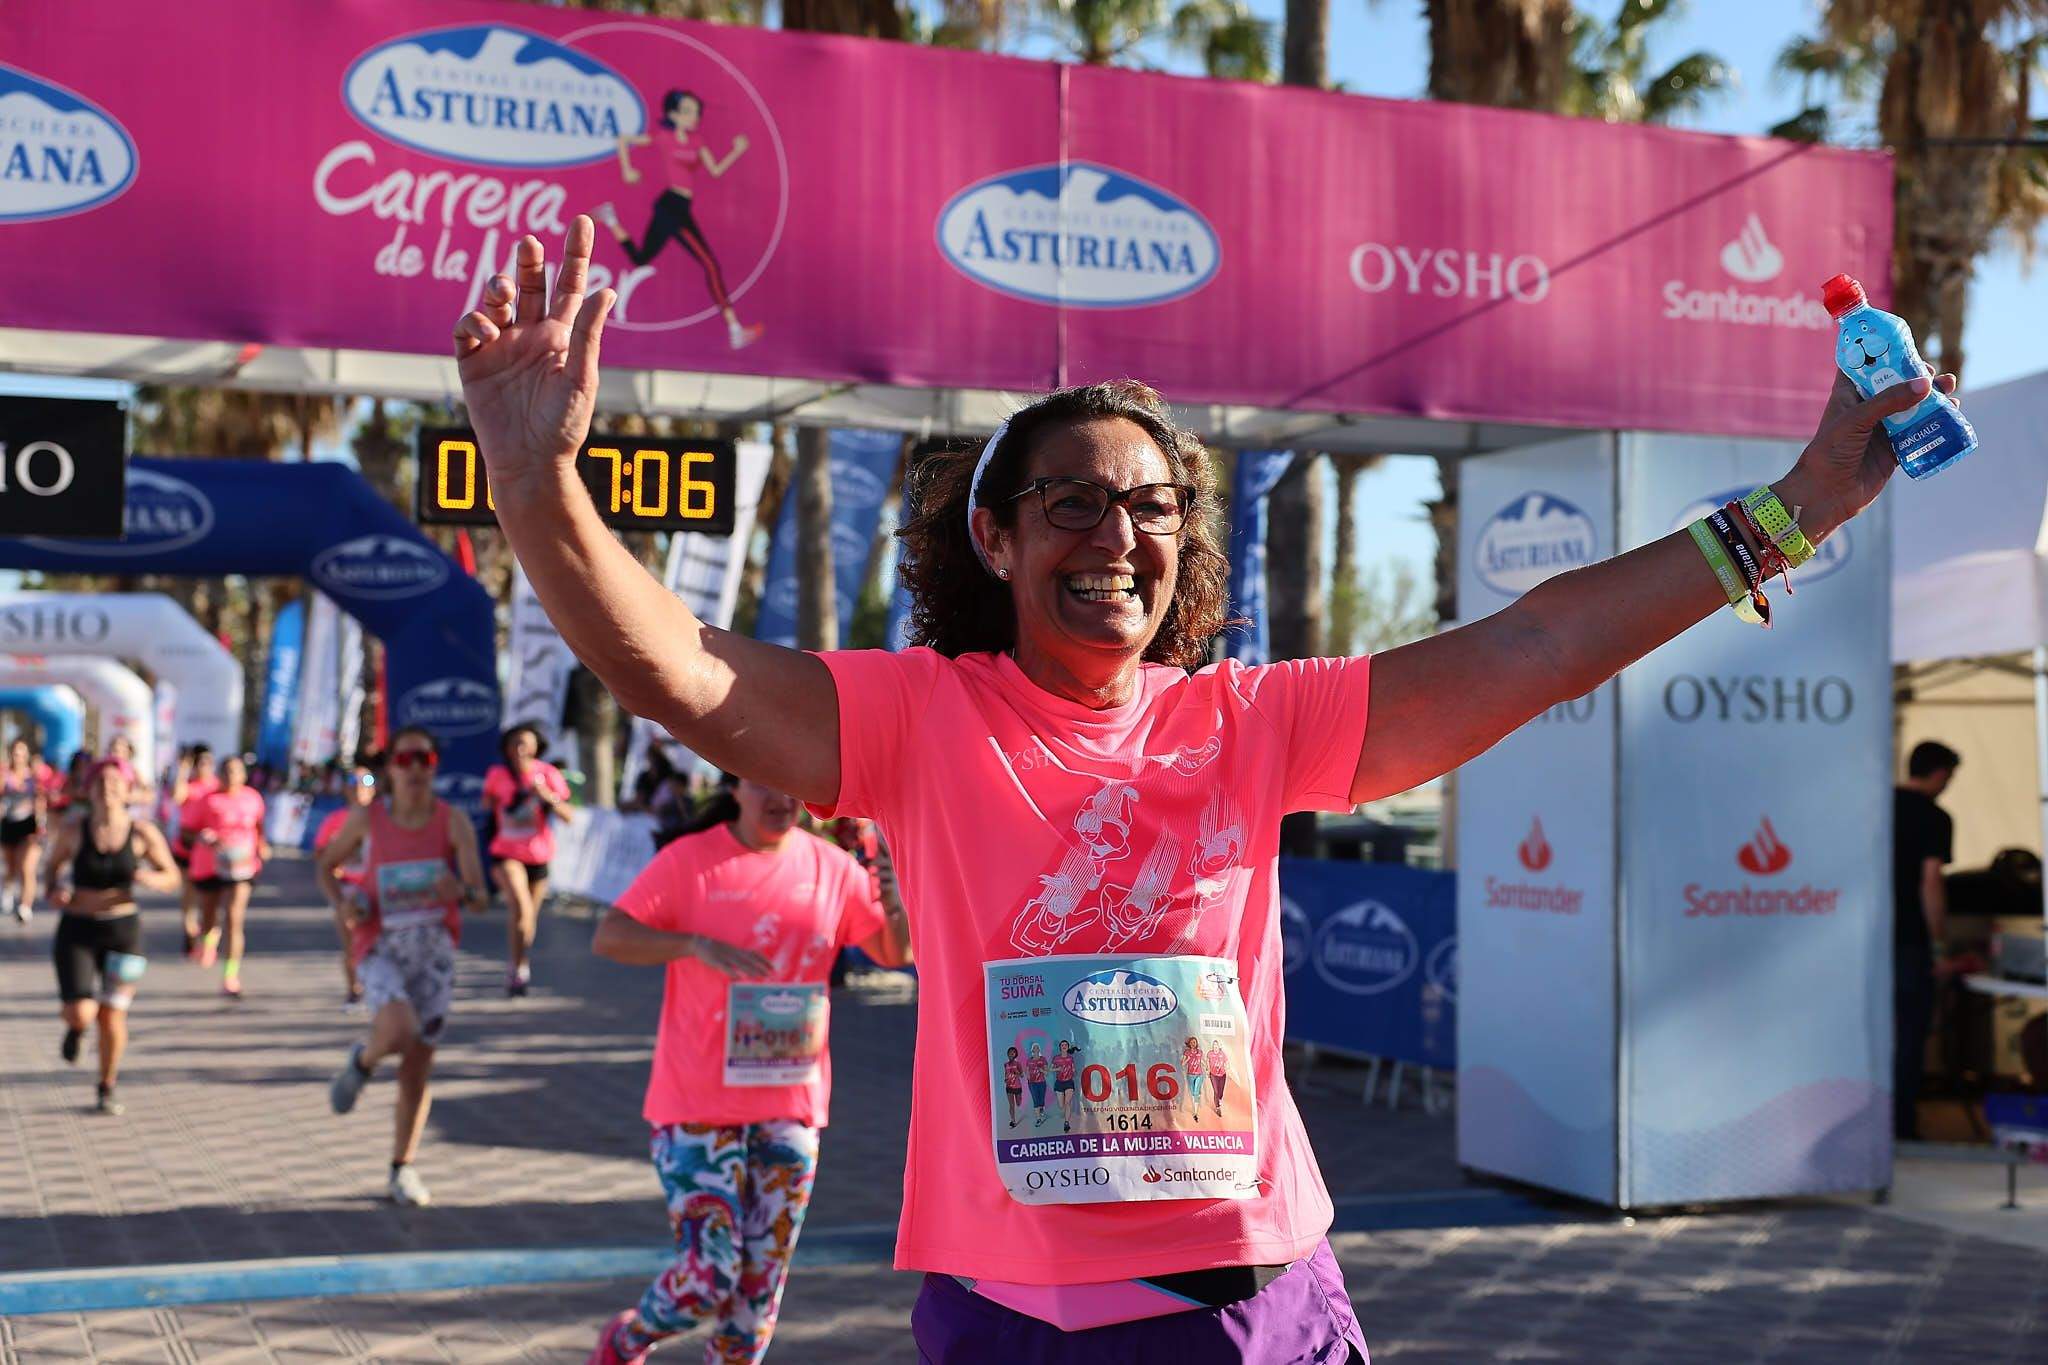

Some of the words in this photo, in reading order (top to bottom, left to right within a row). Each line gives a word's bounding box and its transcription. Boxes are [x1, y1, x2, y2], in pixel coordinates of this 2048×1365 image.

[370, 65, 621, 138] ASTURIANA
[313, 140, 568, 236] Carrera
[375, 226, 424, 278] de
[432, 228, 469, 282] la
[963, 208, 1196, 276] ASTURIANA
[1349, 242, 1550, 304] OYSHO
[1664, 673, 1855, 726] OYSHO
[1485, 876, 1583, 915] Santander
[1683, 883, 1841, 917] Santander
[1000, 977, 1010, 987] TU
[1012, 975, 1045, 986] DORSAL
[1001, 984, 1045, 999] SUMA
[1089, 987, 1126, 996] CENTRAL
[1072, 990, 1170, 1013] ASTURIANA
[1081, 1062, 1180, 1103] 016
[1106, 1114, 1152, 1131] 1614
[1010, 1140, 1075, 1158] CARRERA
[1080, 1138, 1098, 1153] DE
[1102, 1137, 1120, 1153] LA
[1124, 1137, 1172, 1152] MUJER
[1184, 1135, 1245, 1150] VALENCIA
[1026, 1167, 1110, 1189] OYSHO
[1164, 1167, 1237, 1182] Santander
